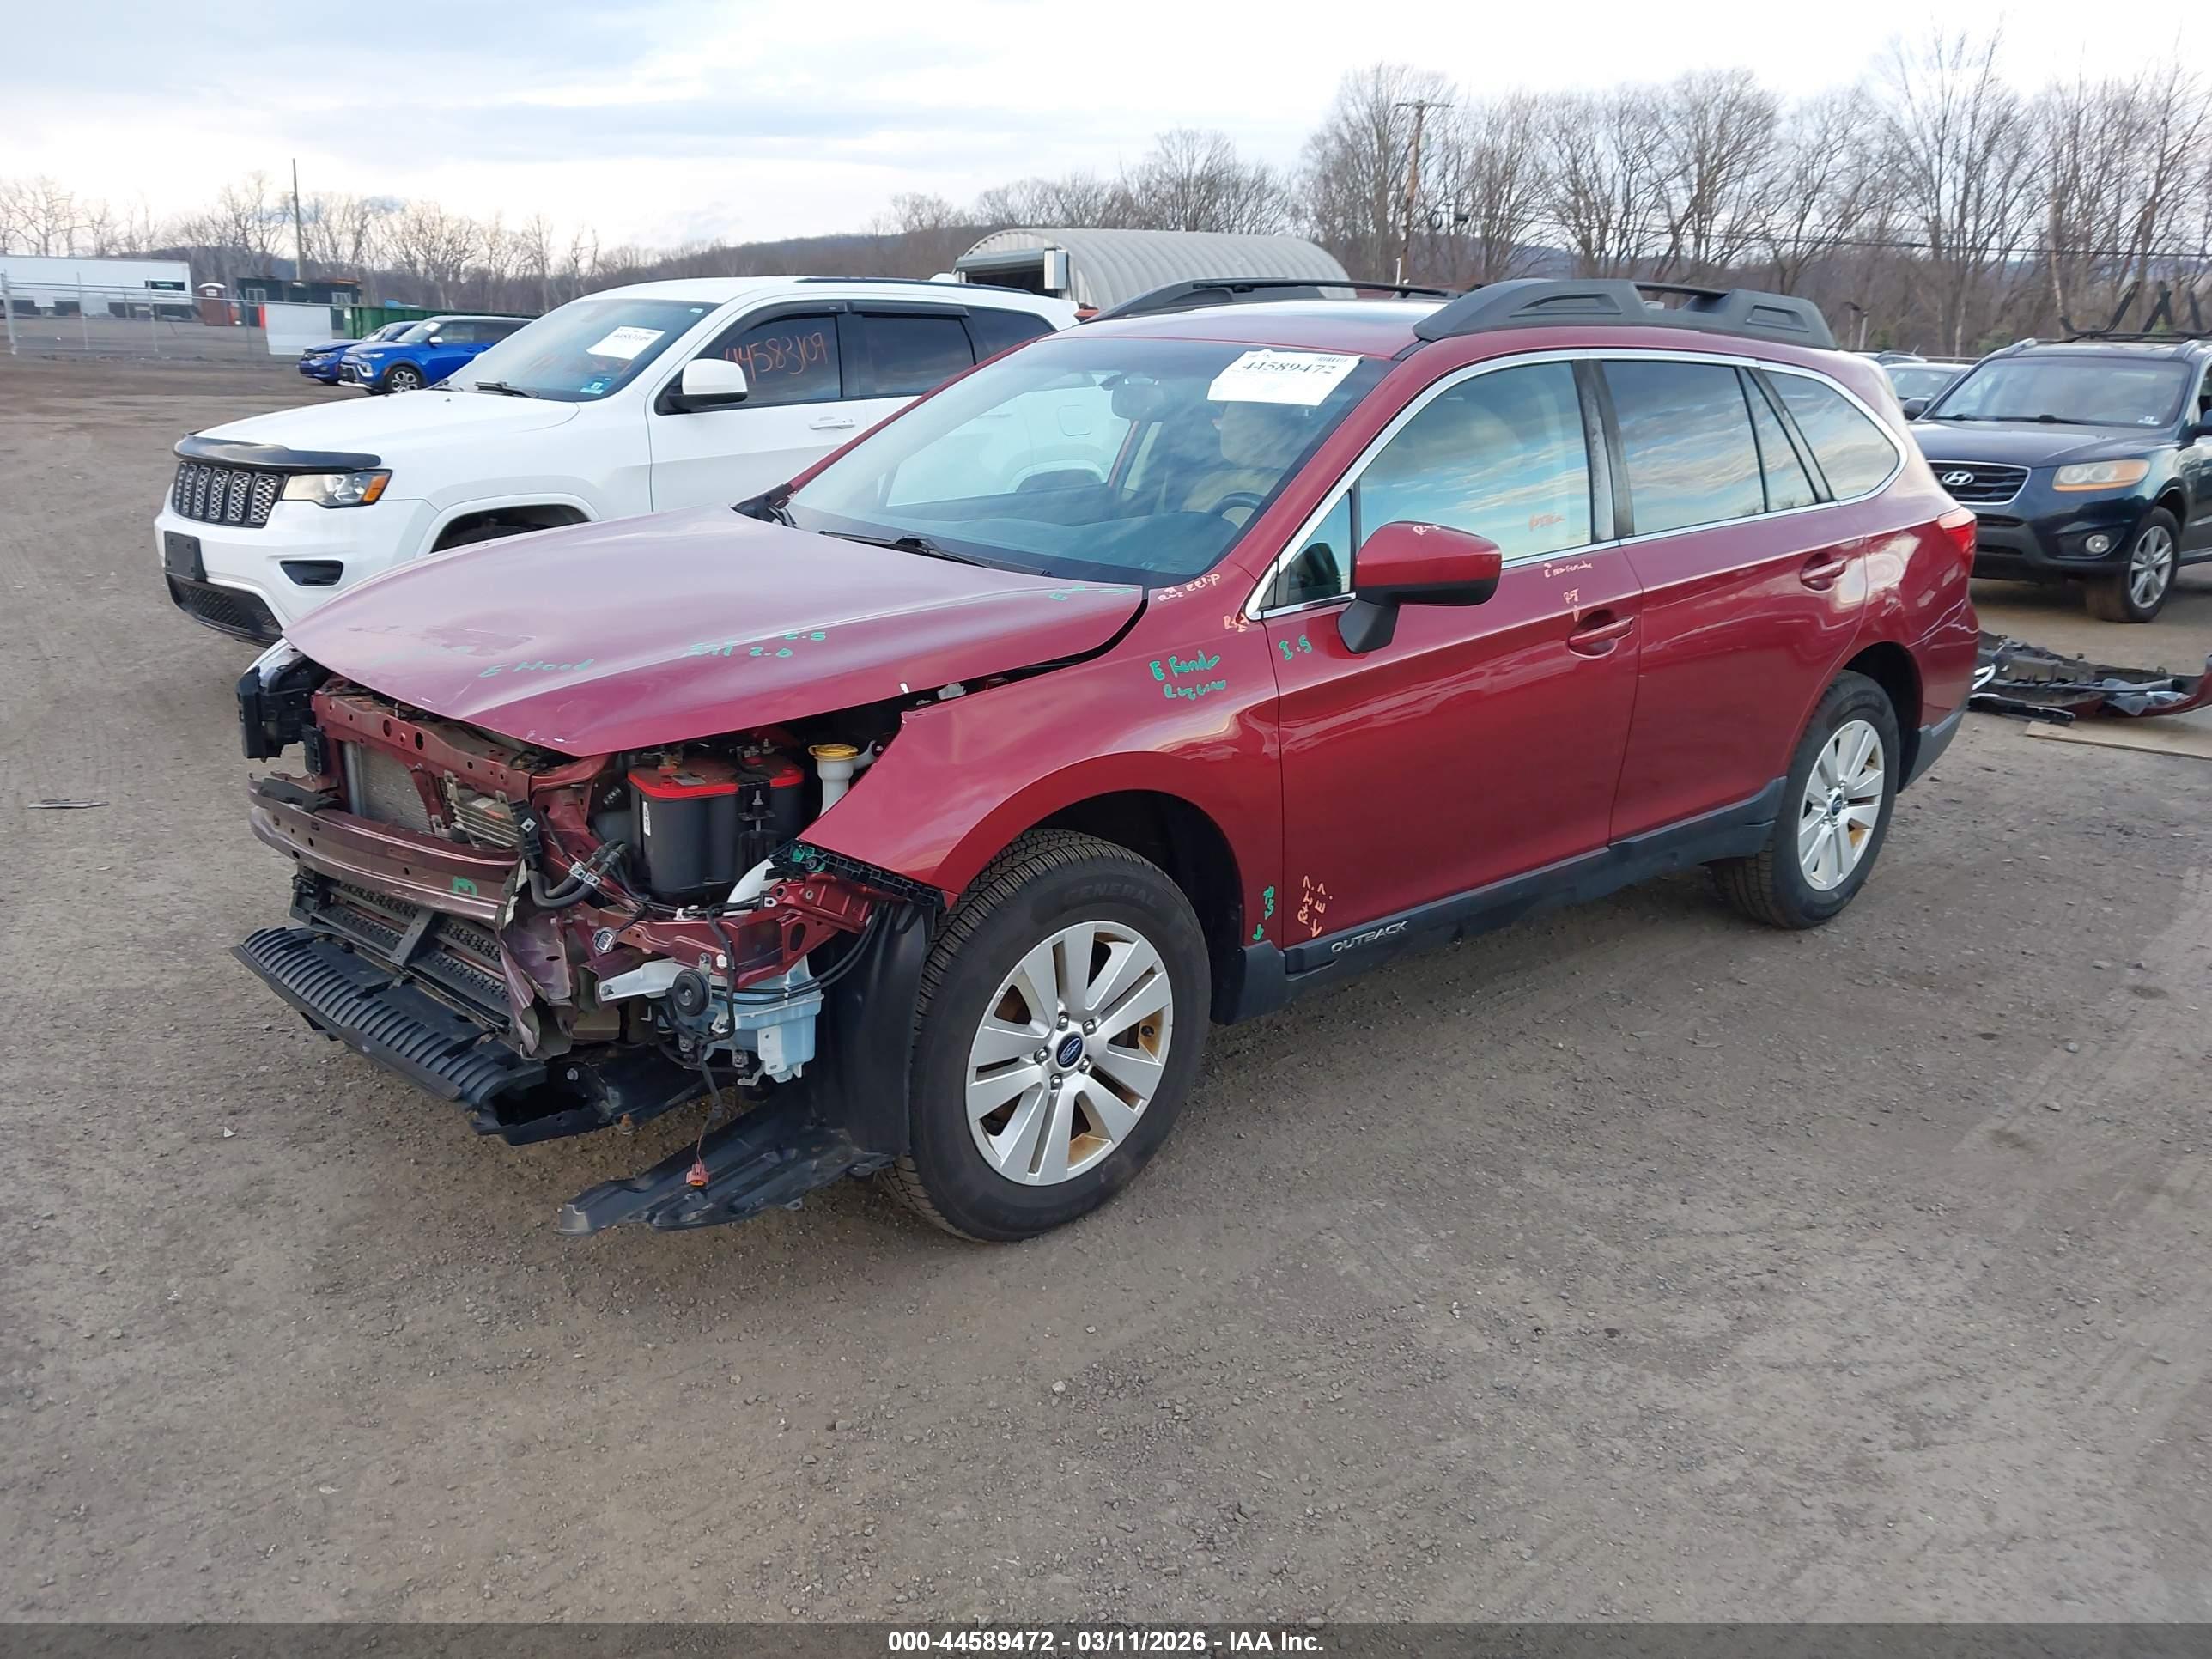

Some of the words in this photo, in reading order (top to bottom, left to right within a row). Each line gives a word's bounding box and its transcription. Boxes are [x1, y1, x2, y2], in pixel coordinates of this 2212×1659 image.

[1243, 361, 1337, 374] 44589472
[512, 659, 595, 673] Hood
[1331, 920, 1409, 953] OUTBACK
